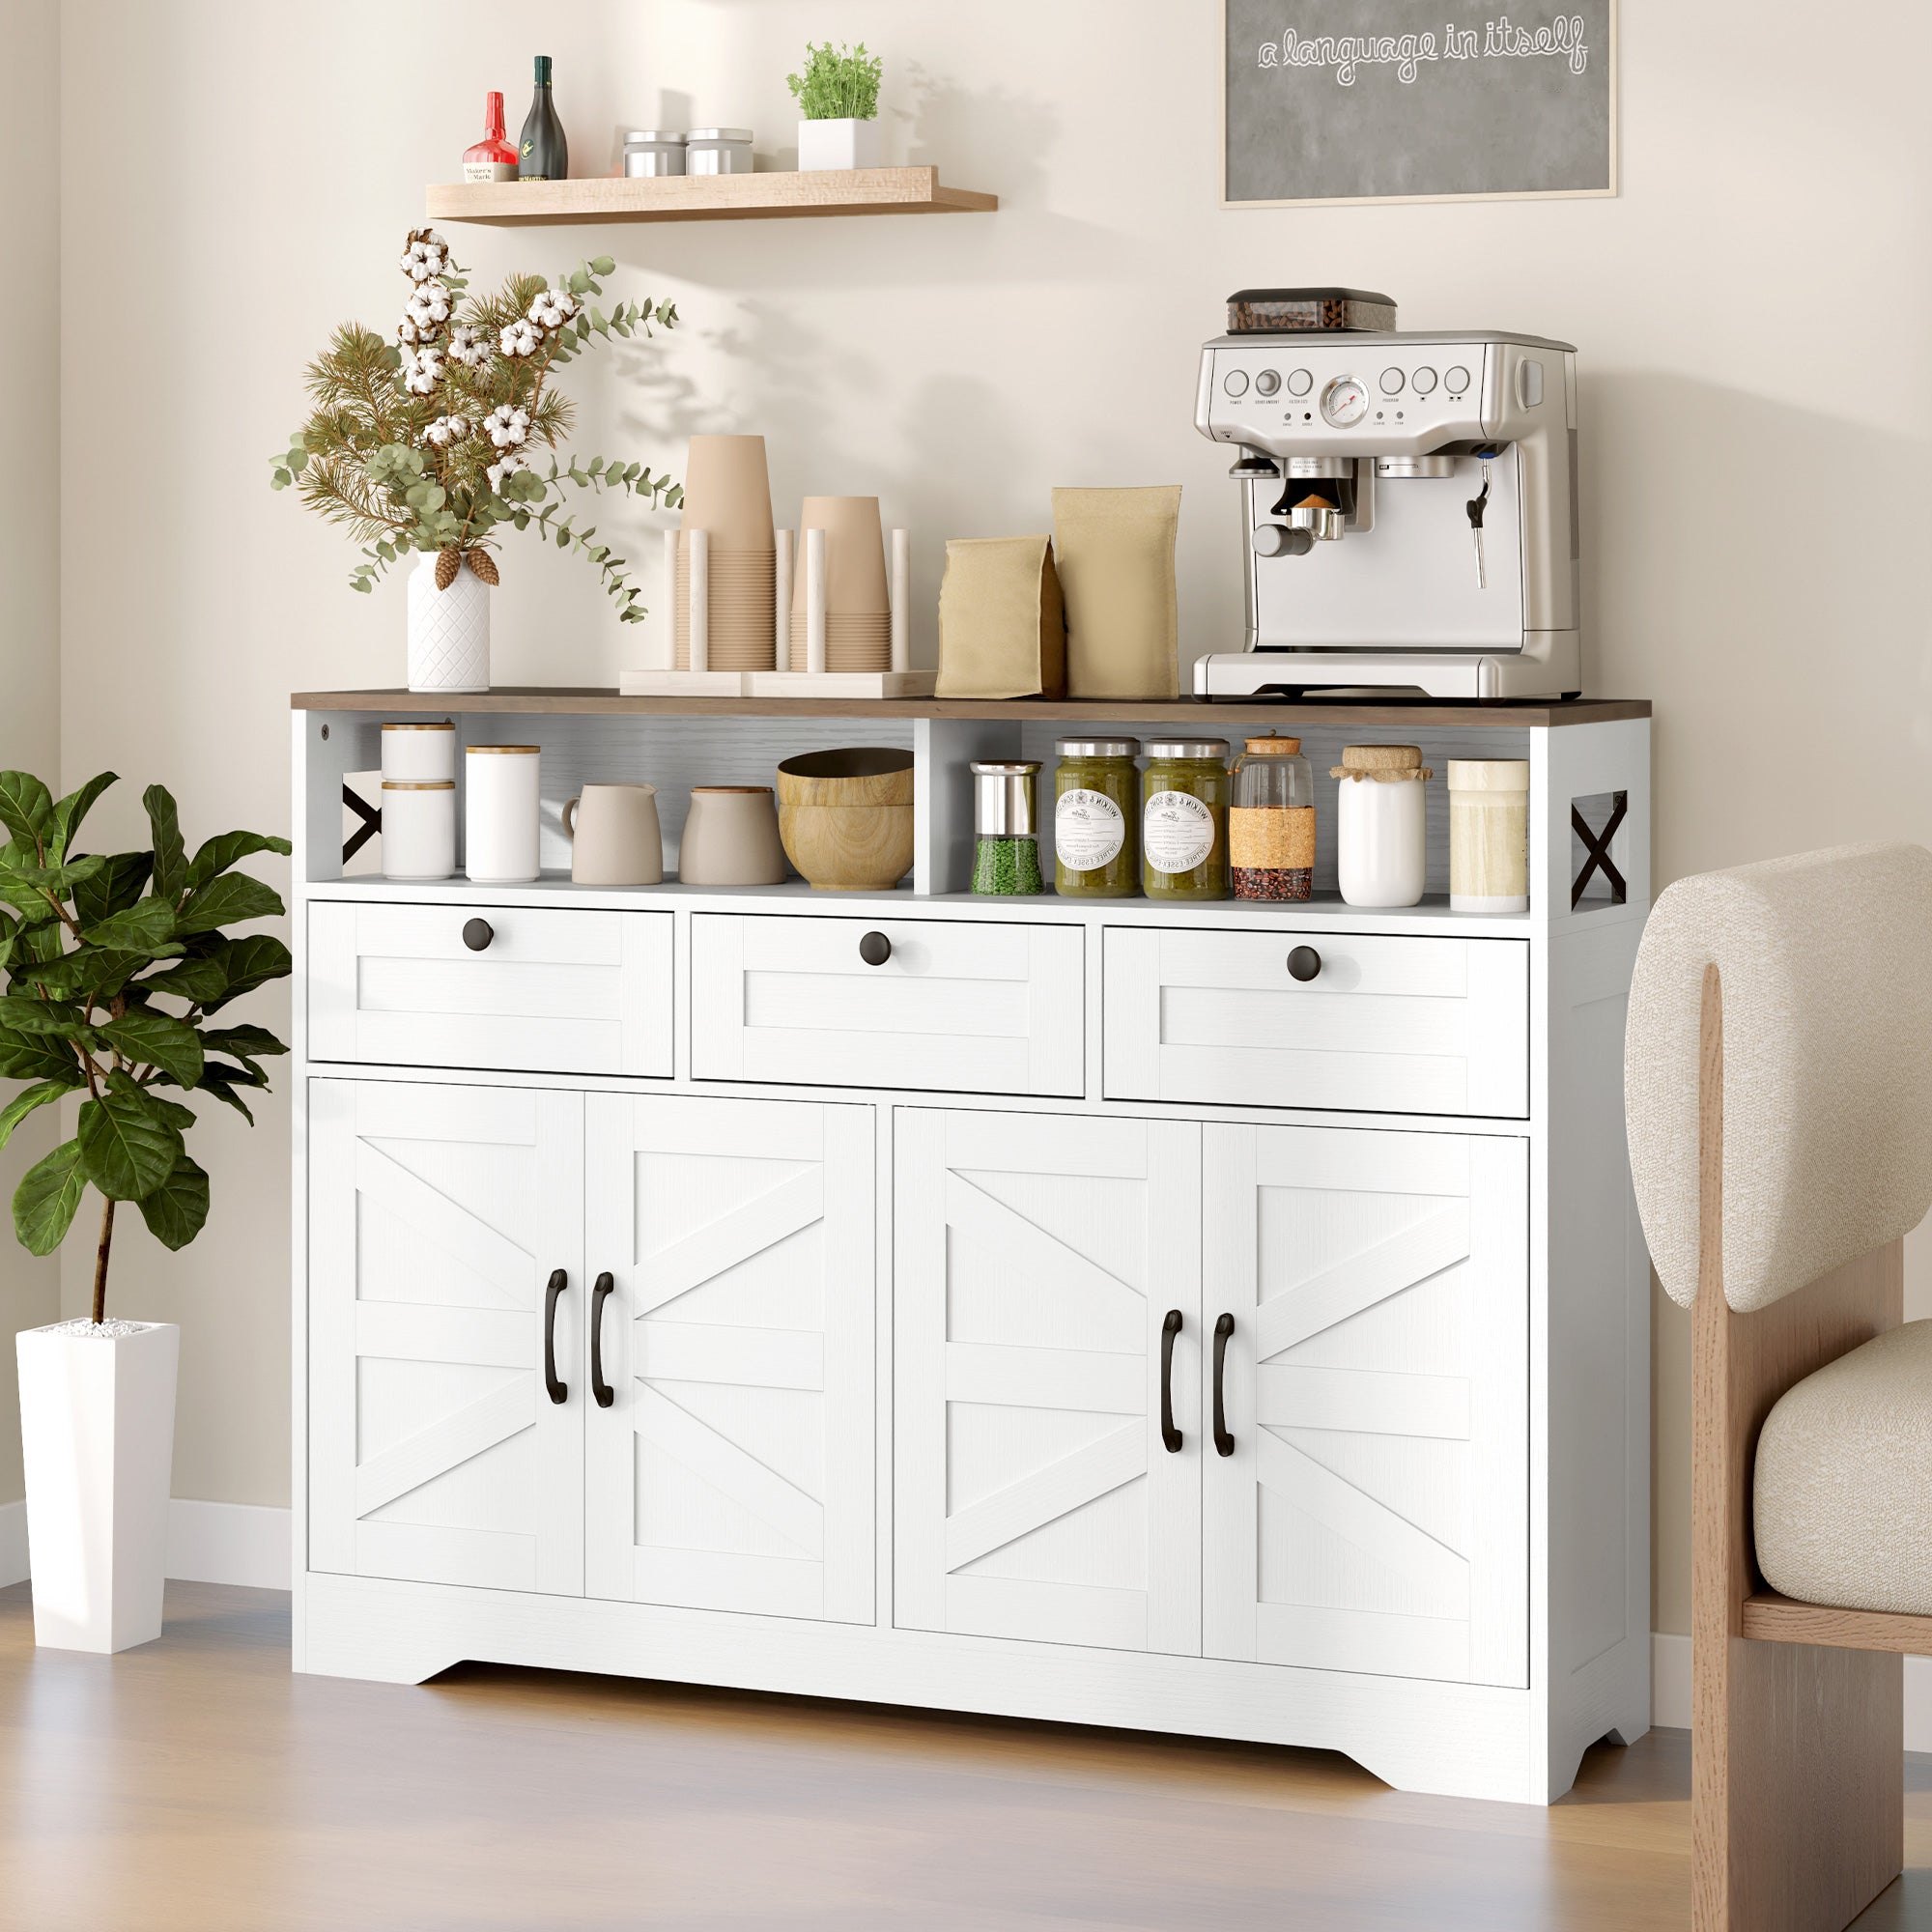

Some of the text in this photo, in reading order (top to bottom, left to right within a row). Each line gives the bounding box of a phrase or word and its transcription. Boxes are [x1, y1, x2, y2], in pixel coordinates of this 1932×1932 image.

[1259, 15, 1588, 86] a language in itself
